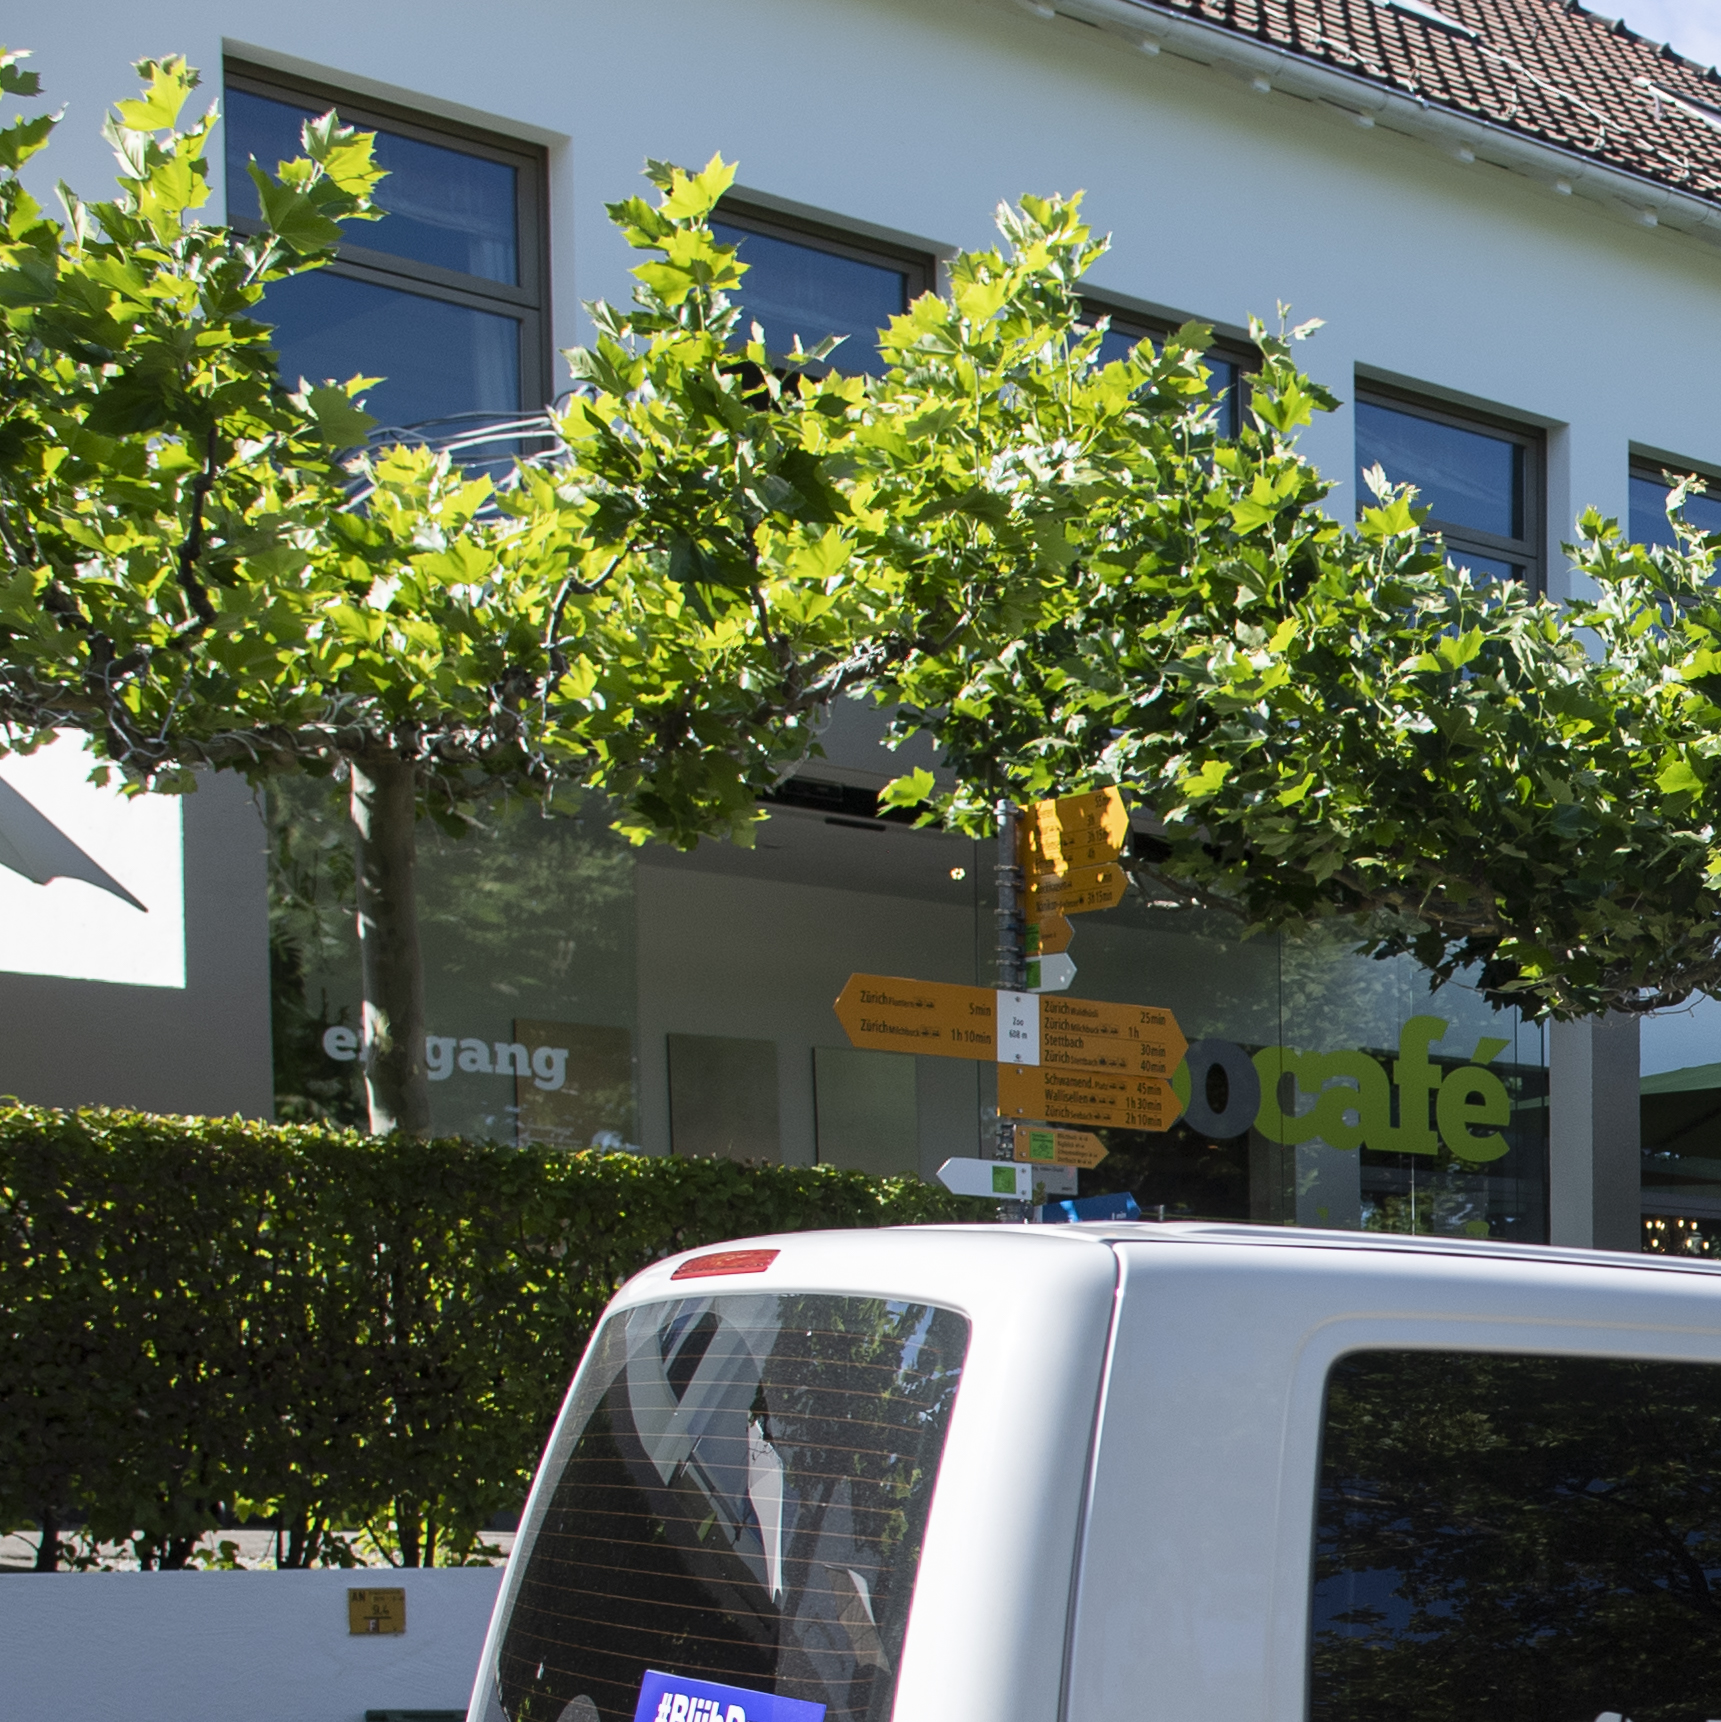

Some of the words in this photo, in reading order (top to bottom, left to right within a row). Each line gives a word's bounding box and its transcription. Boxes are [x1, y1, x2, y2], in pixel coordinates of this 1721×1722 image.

[860, 990, 889, 1005] Zürich
[1044, 1001, 1070, 1014] Zürich
[860, 1019, 889, 1034] Zürich
[1044, 1017, 1070, 1031] Zürich
[1044, 1033, 1085, 1050] Stettbach
[1044, 1050, 1071, 1064] Zürich
[1045, 1089, 1089, 1105] Wallisellen
[1045, 1105, 1071, 1119] Zürich
